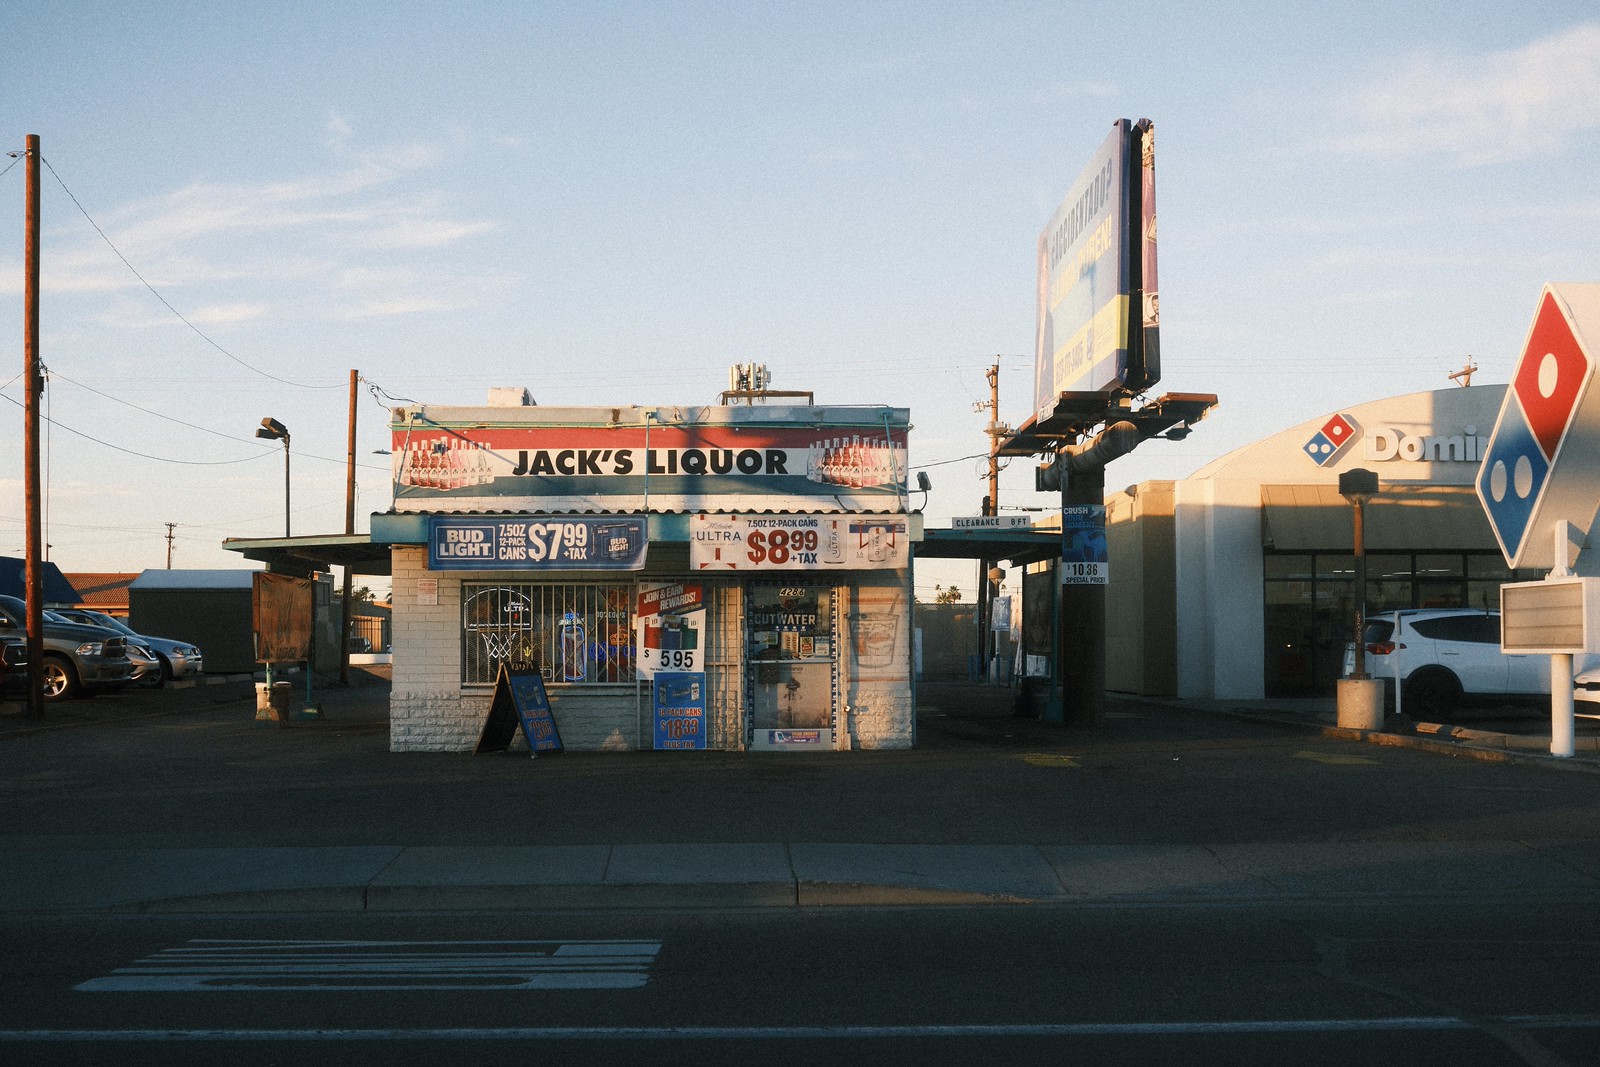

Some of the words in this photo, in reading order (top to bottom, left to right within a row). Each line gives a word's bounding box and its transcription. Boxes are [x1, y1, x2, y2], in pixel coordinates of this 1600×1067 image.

[512, 449, 634, 476] JACK'S
[648, 449, 788, 476] LIQUOR
[1063, 507, 1089, 515] CRUSH
[747, 519, 768, 528] 7.5OZ
[768, 519, 798, 528] 12-PACK
[799, 519, 819, 528] CANS
[956, 518, 1000, 527] CLEARANCE
[446, 529, 484, 543] BUD
[499, 524, 526, 537] 7.5OZ
[696, 531, 742, 541] ULTRA
[499, 538, 526, 547] 12-PACK
[608, 544, 629, 552] LIGHT
[440, 543, 490, 556] LIGHT
[499, 547, 526, 560] CANS
[563, 547, 587, 560] +TAX
[790, 553, 818, 564] +TAX
[644, 591, 660, 604] JOIN
[660, 589, 666, 599] &
[666, 584, 684, 597] EARN
[780, 588, 805, 596] 4286
[660, 591, 696, 610] REWARDS!
[754, 614, 816, 625] CUTWATER
[685, 707, 702, 717] CANS
